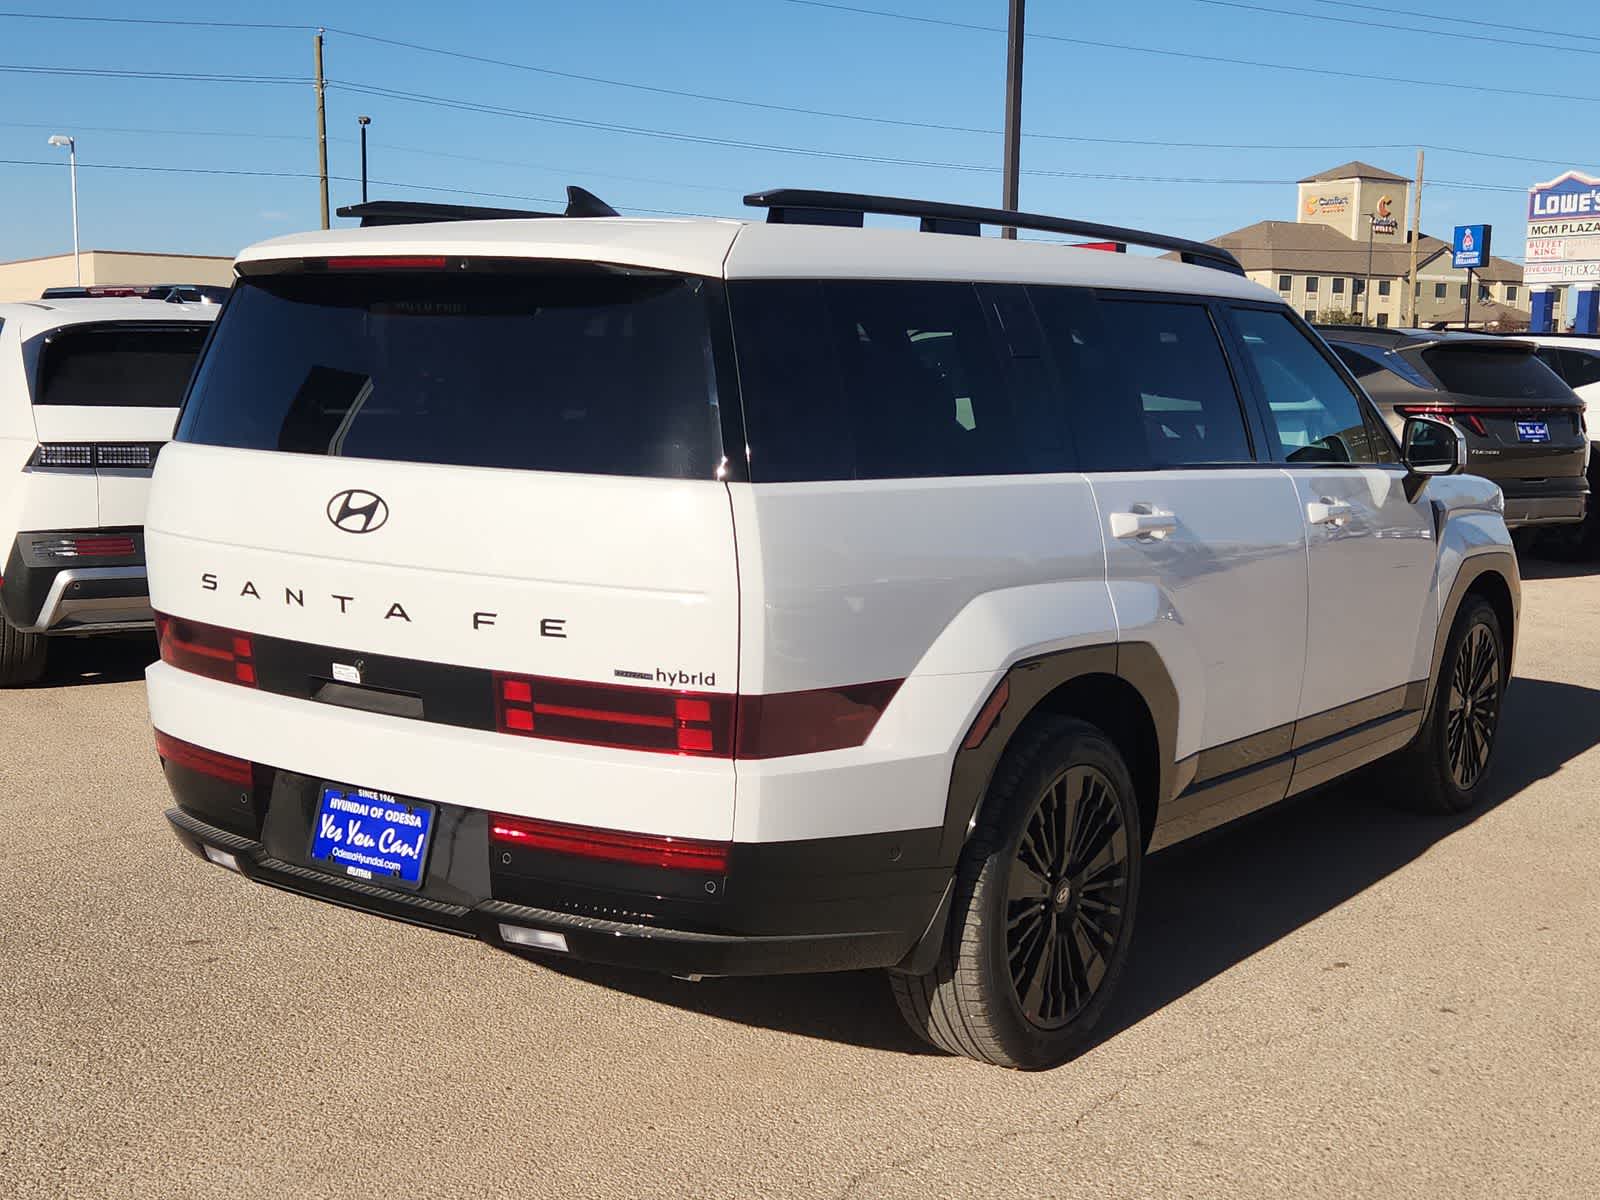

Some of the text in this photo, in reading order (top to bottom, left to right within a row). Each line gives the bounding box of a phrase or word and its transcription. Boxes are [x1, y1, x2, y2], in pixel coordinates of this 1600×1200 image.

[1531, 222, 1600, 235] MCM PLAZA
[1528, 240, 1563, 248] BUFFET
[1534, 248, 1557, 256] KING
[201, 573, 567, 638] SANTA FE
[656, 667, 716, 686] hybrid
[358, 789, 379, 801] SINCE
[330, 798, 422, 828] HYUNDAI OF ODESSA
[320, 813, 425, 860] Yes You Can!
[332, 846, 401, 871] OdessaHyundai.com
